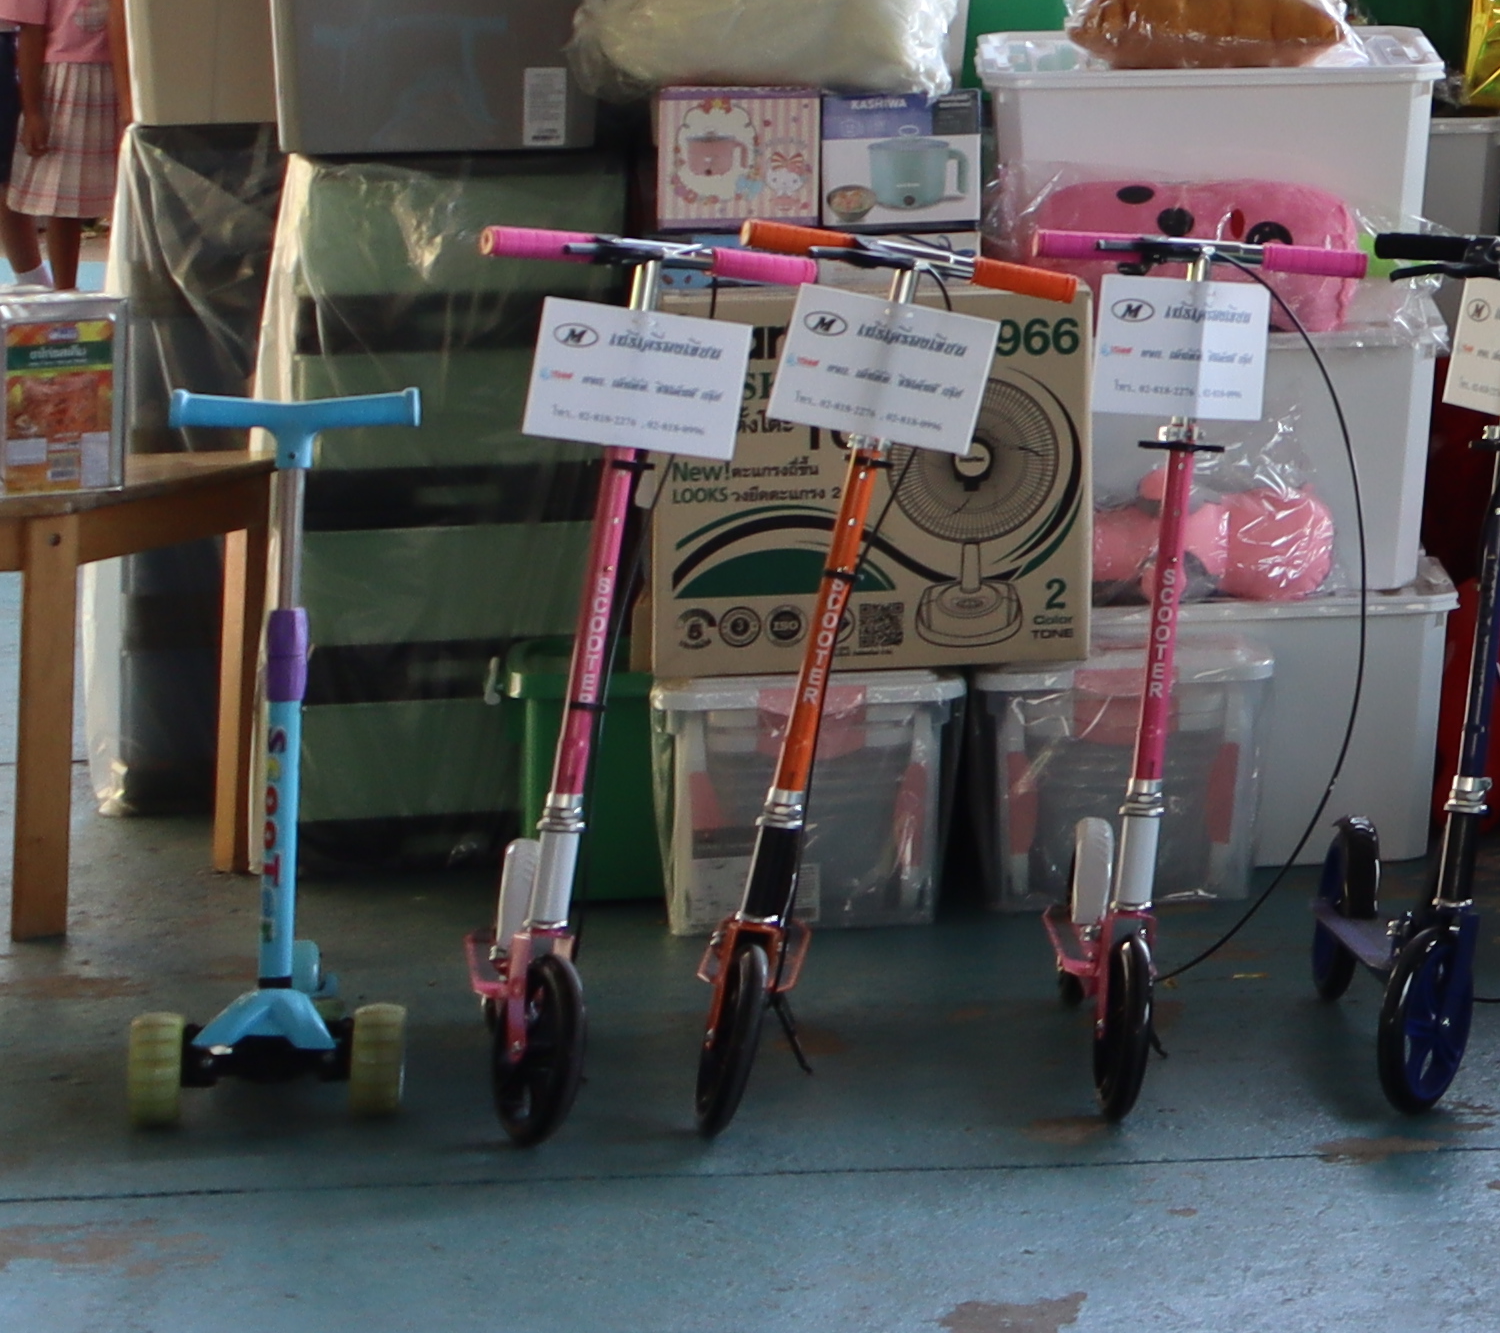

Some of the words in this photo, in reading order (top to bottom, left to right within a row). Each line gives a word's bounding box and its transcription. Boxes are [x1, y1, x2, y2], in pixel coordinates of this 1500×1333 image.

[851, 97, 908, 110] KASHIWA
[672, 461, 731, 482] New!
[672, 487, 729, 504] LOOKS
[1044, 577, 1068, 610] 2
[772, 618, 799, 630] ISO
[1033, 613, 1073, 626] Color
[1031, 627, 1074, 639] TONE
[1150, 567, 1178, 698] SCOOTER
